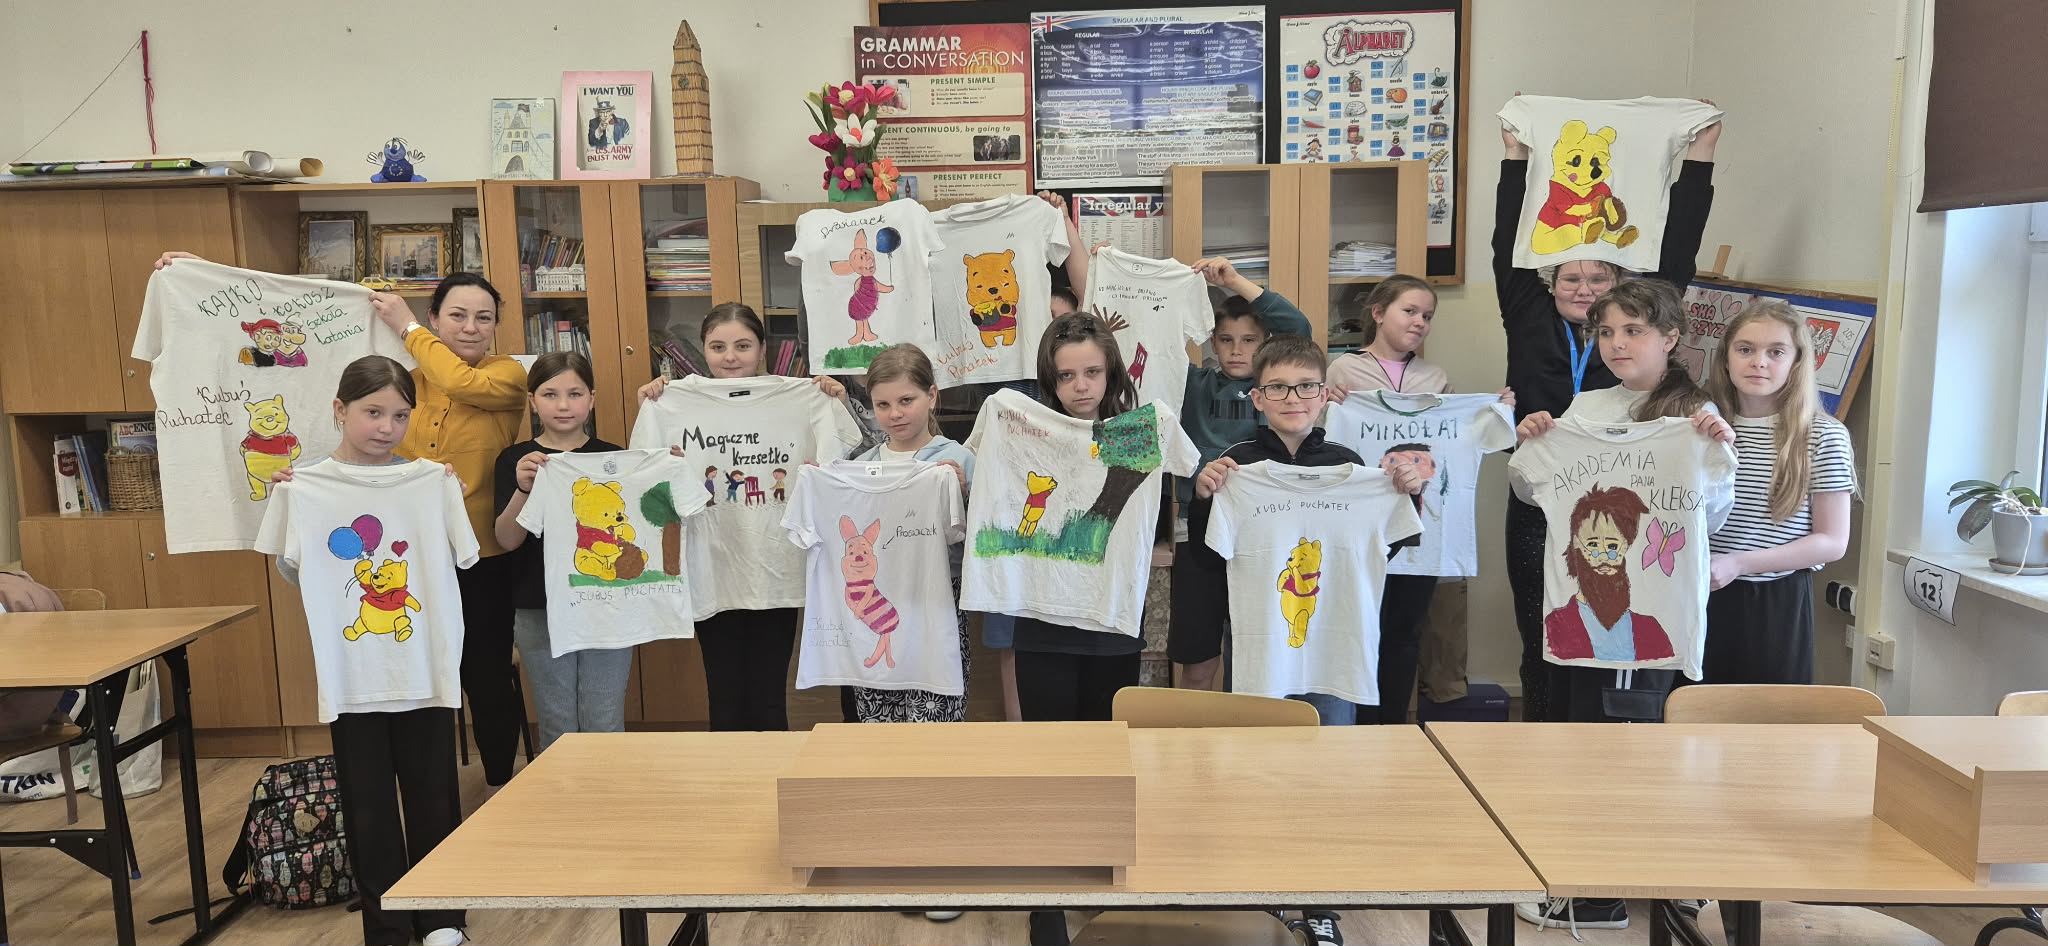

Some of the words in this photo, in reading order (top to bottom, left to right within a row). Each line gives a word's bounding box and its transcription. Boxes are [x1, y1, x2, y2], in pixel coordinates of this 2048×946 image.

[861, 36, 962, 53] GRAMMAR
[1335, 28, 1405, 57] ALPHABET
[861, 54, 875, 69] in
[884, 51, 1024, 69] CONVERSATION
[930, 78, 965, 86] PRESENT
[968, 77, 996, 85] SIMPLE
[583, 88, 587, 96] I
[589, 87, 615, 95] WANT
[616, 86, 634, 96] YOU
[906, 126, 962, 134] CONTINUOUS,
[977, 126, 1000, 135] going
[611, 144, 633, 154] ARMY
[587, 154, 609, 162] ENLIST
[1089, 201, 1151, 214] Irregular
[198, 279, 263, 317] KAJKO
[273, 286, 335, 317] KOKOSZ
[157, 406, 234, 429] Puchatek
[683, 425, 760, 454] Magiczne
[1630, 474, 1655, 487] PANA
[1650, 486, 1704, 511] KLEKSA
[1921, 582, 1936, 602] 12
